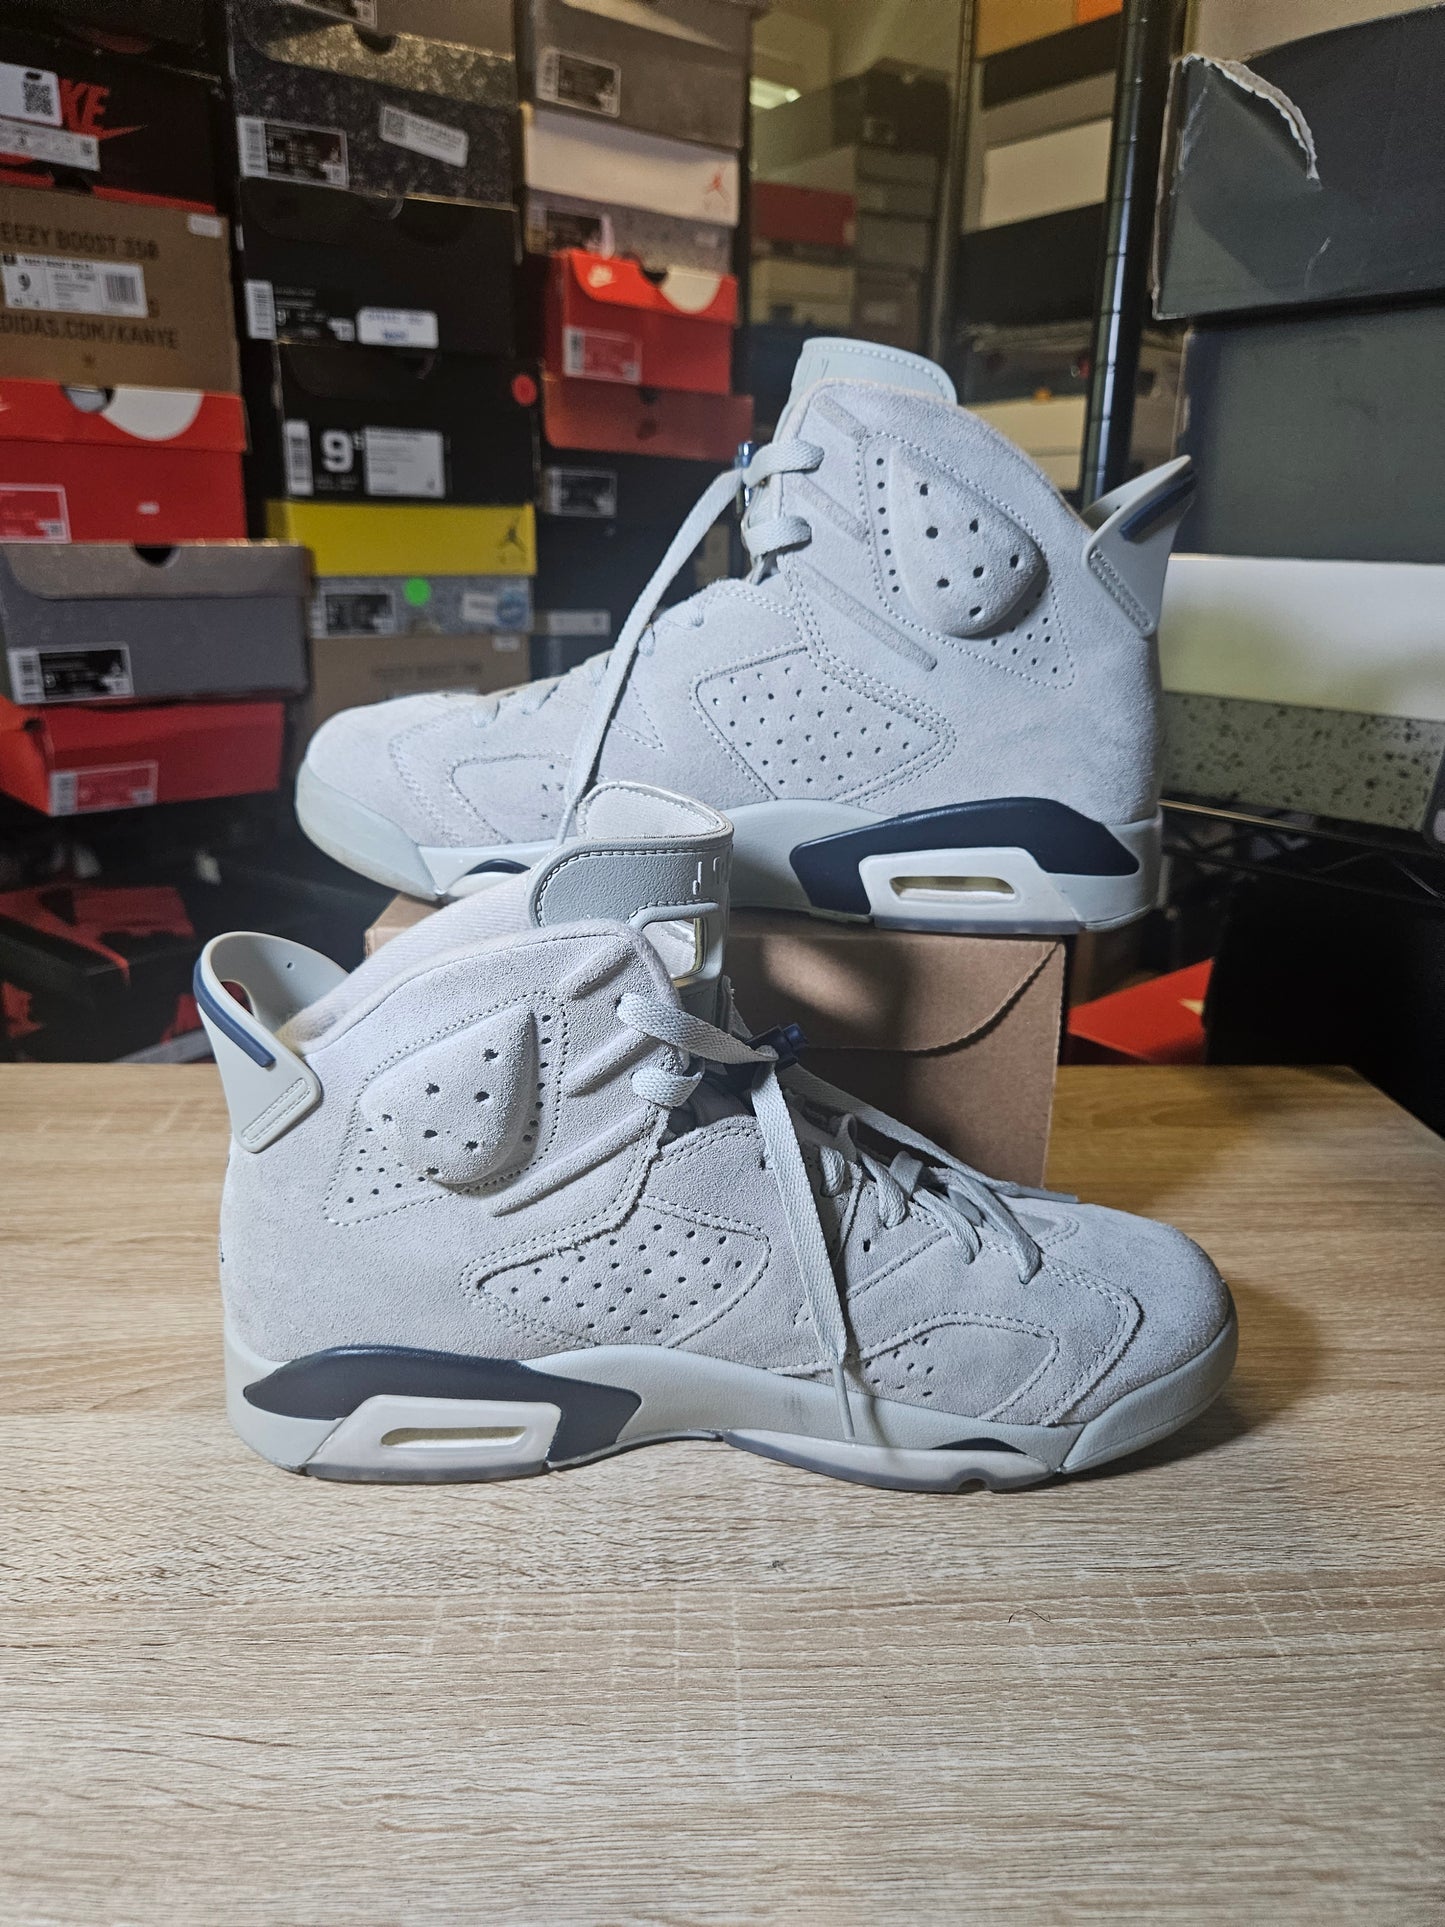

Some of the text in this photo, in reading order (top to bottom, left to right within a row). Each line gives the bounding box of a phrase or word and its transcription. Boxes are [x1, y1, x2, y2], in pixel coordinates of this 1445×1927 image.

[59, 79, 110, 134] KE
[0, 221, 49, 247] EEZY
[55, 228, 117, 255] BOOST
[18, 272, 31, 291] 9
[0, 313, 178, 350] DIDAS.COM/KANYE
[322, 430, 354, 472] 9
